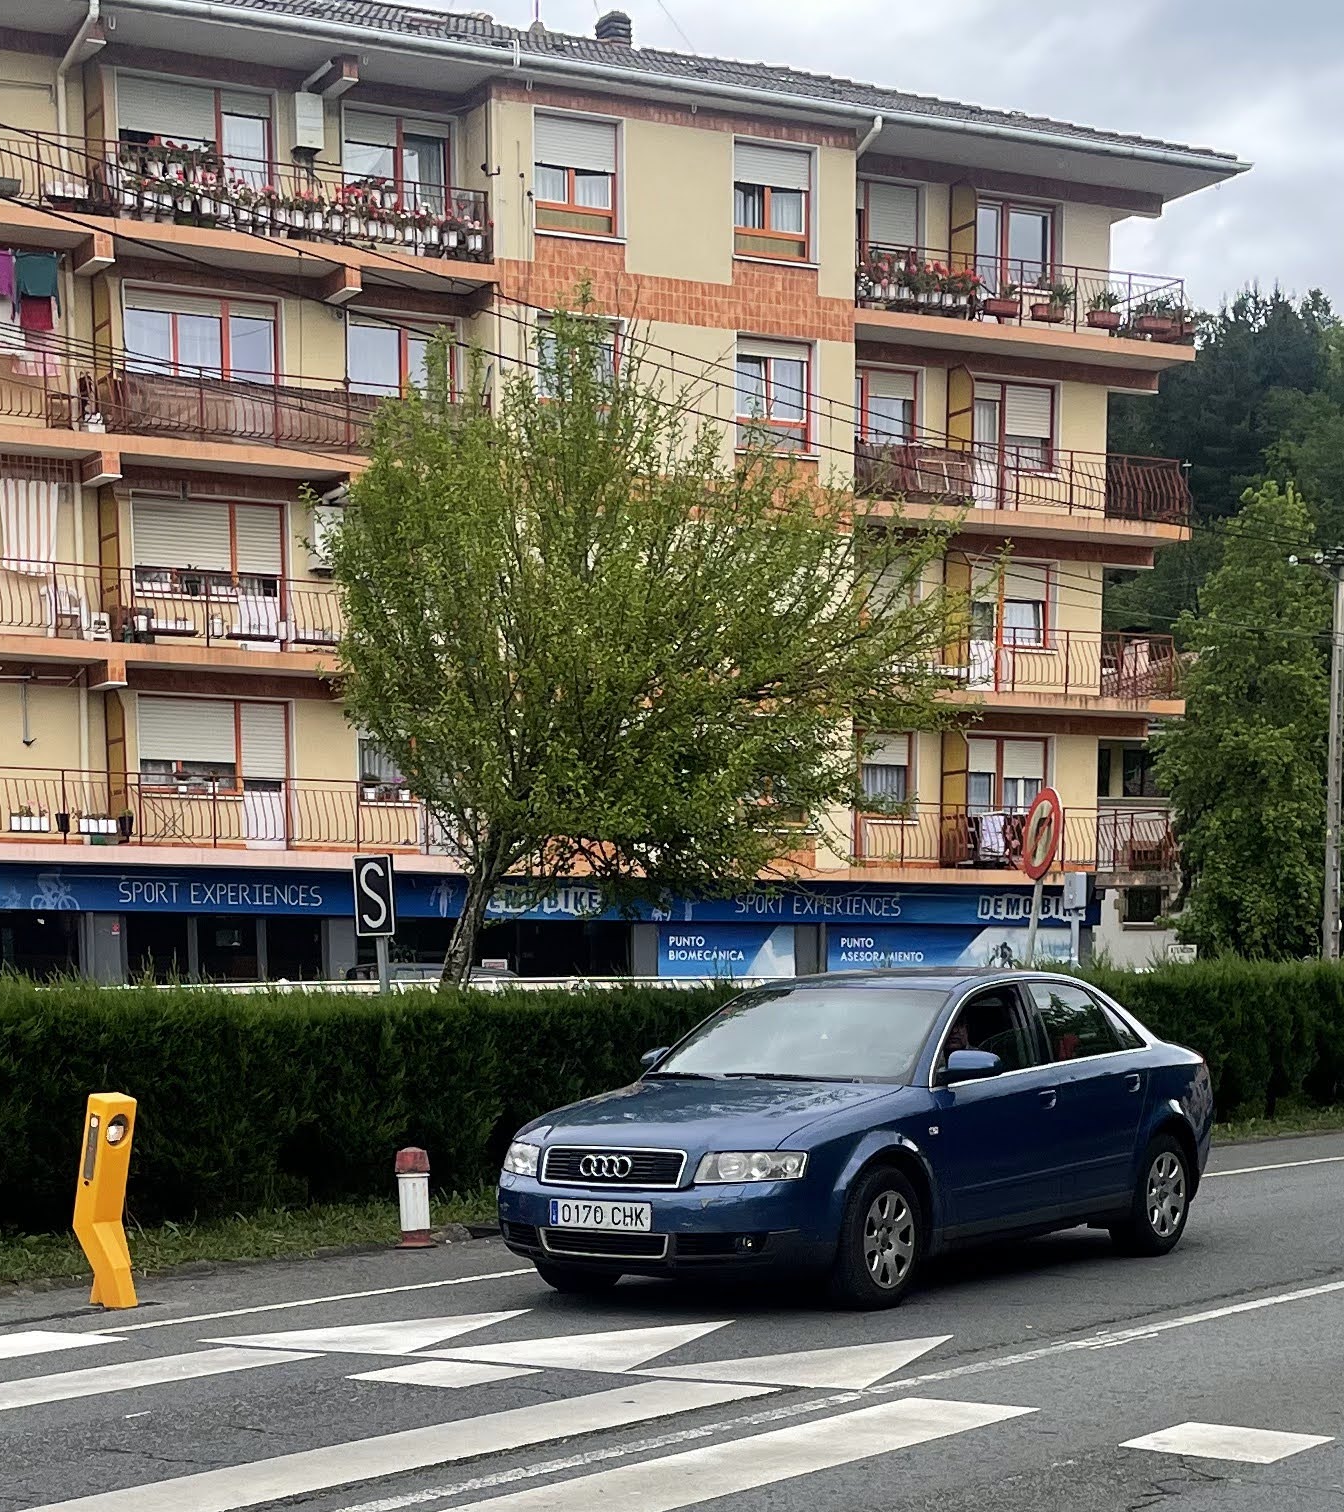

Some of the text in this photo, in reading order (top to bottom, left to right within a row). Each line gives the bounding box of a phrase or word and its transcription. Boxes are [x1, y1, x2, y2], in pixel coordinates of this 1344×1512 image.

[118, 881, 323, 907] SPORT EXPERIENCES
[359, 861, 387, 929] S
[734, 894, 901, 917] SPORT EXPERIENCES
[980, 897, 1033, 917] DEMO
[668, 935, 706, 948] PUNTO
[840, 936, 875, 949] PUNTO
[668, 946, 745, 962] BIOMECÁNICA
[840, 951, 925, 963] ASESORAMIENTO
[561, 1203, 646, 1228] 0170 CHK
